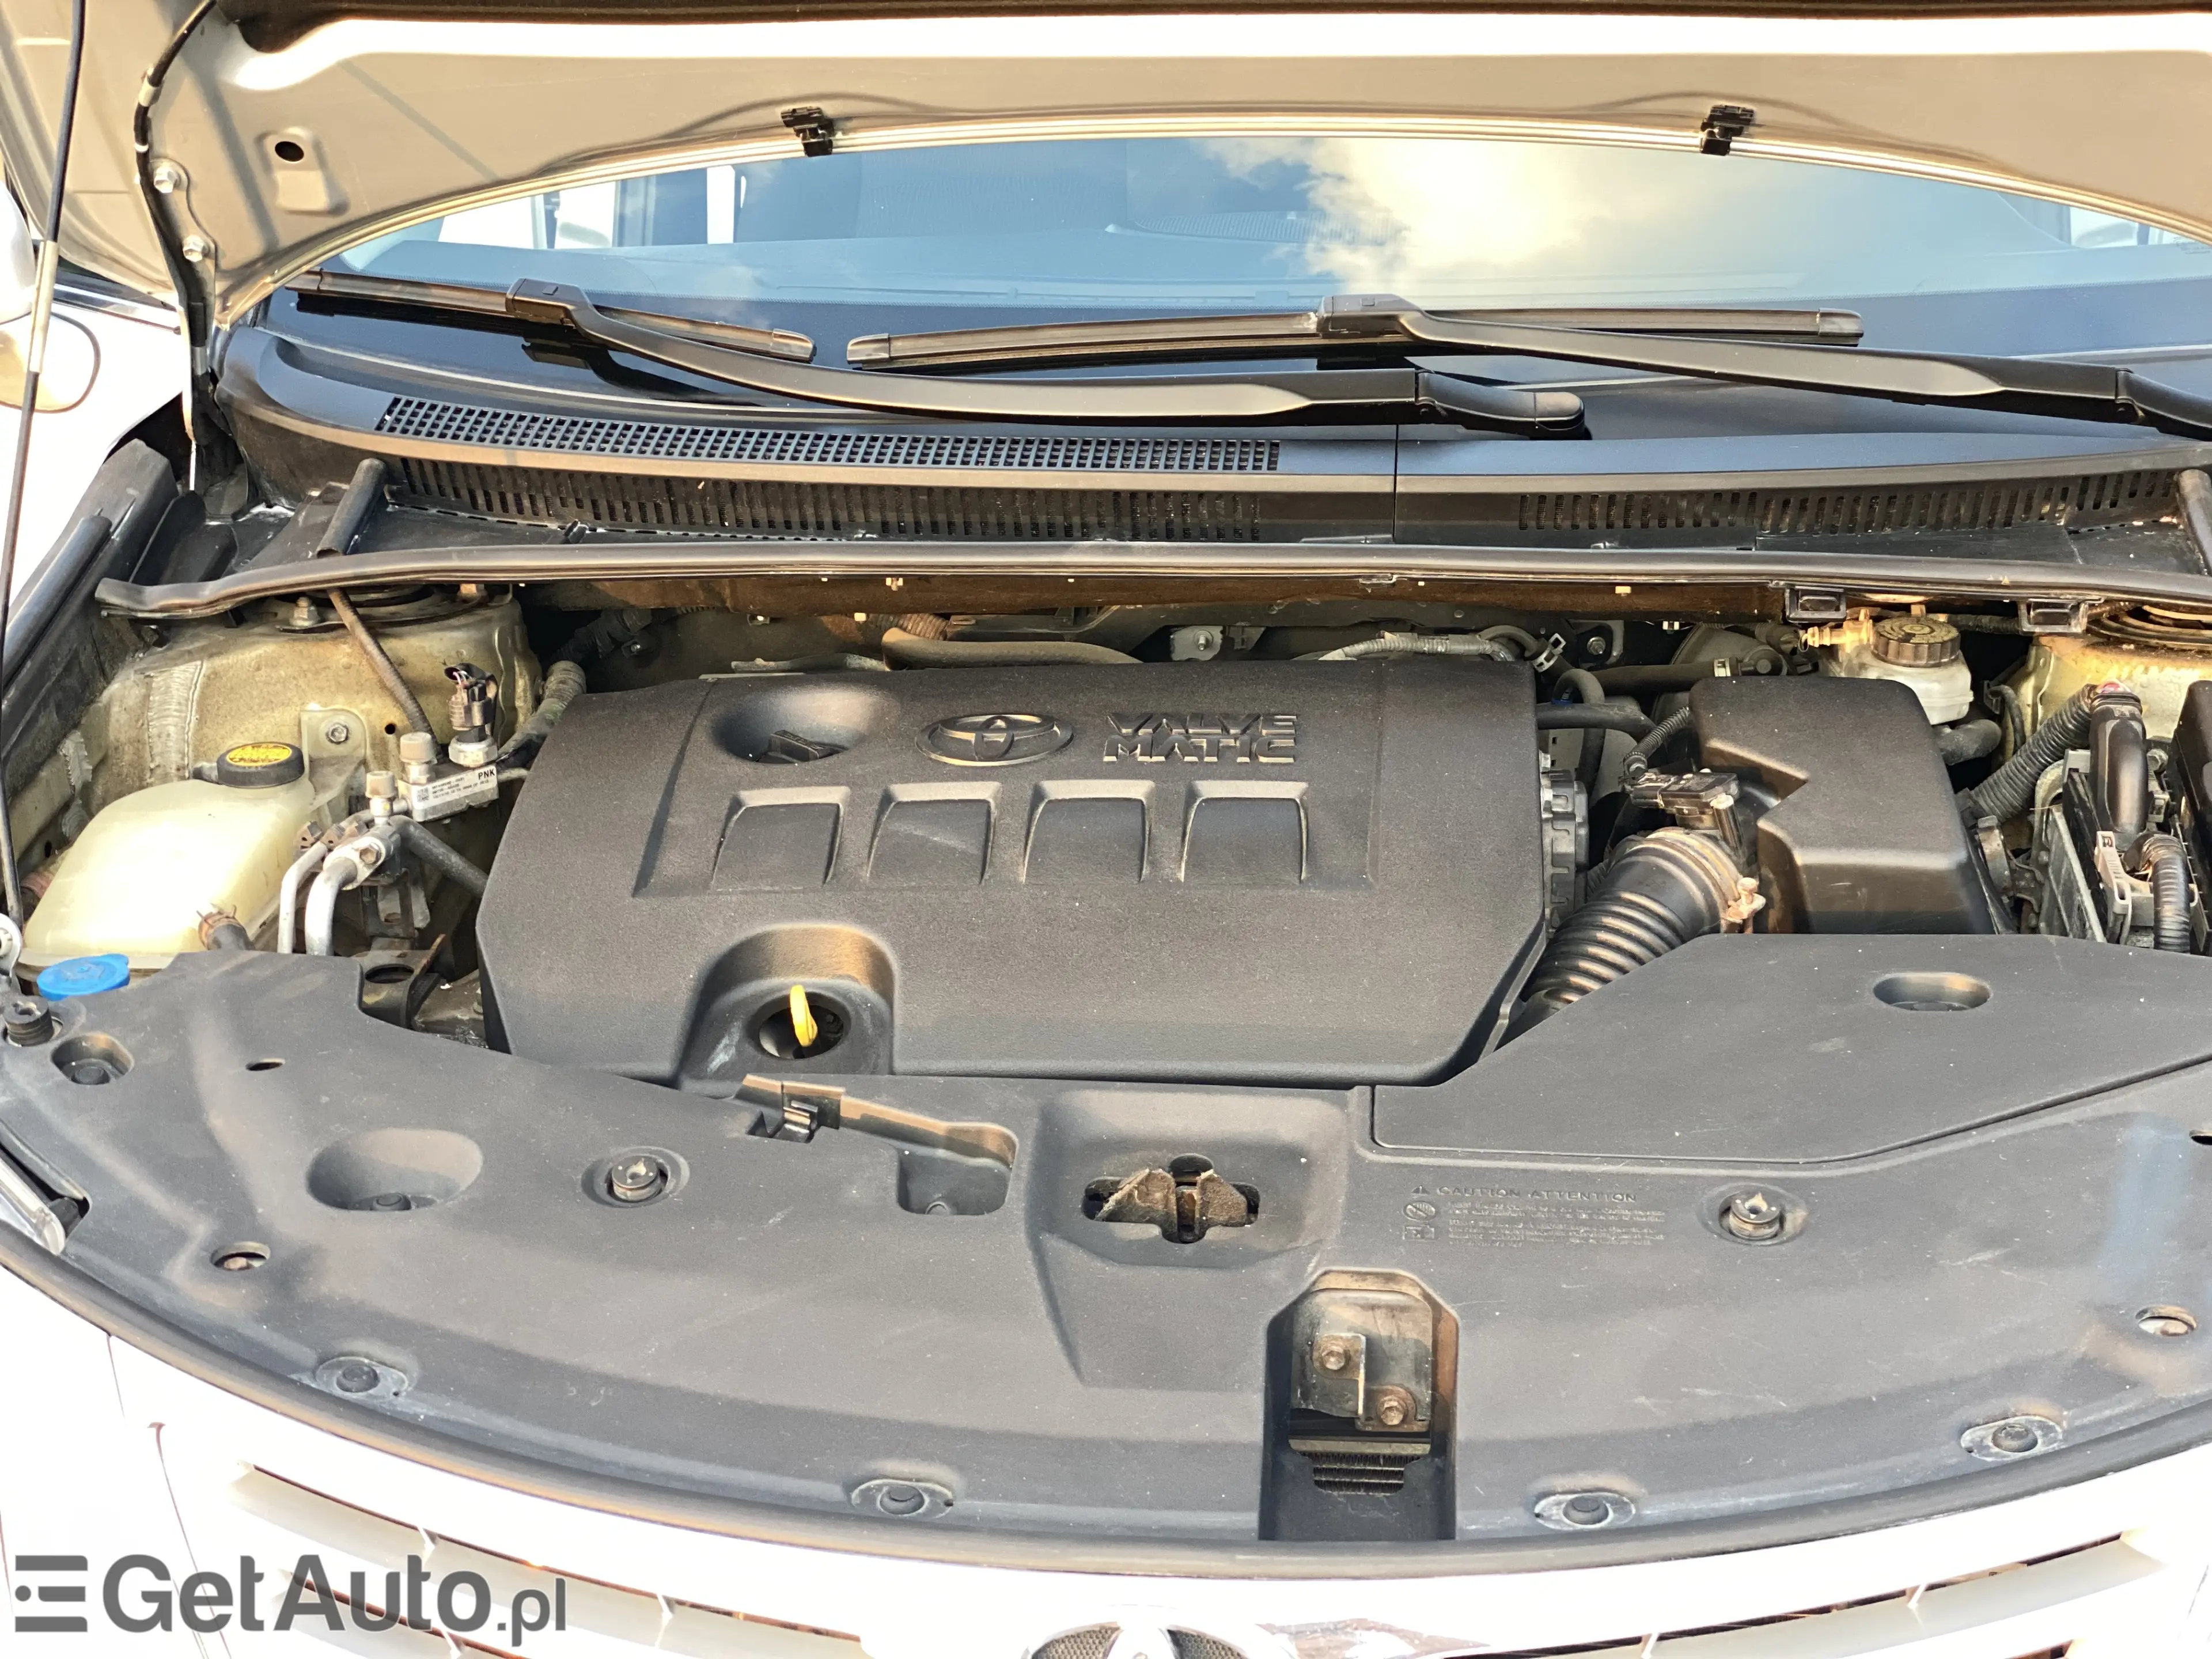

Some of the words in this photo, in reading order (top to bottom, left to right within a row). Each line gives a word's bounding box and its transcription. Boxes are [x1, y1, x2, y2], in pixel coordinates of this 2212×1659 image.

[1105, 713, 1298, 735] VALVE
[1103, 734, 1296, 763] MATIC
[478, 768, 495, 780] PNK
[1436, 1186, 1521, 1198] CAUTION
[1528, 1189, 1637, 1203] ATTENTION
